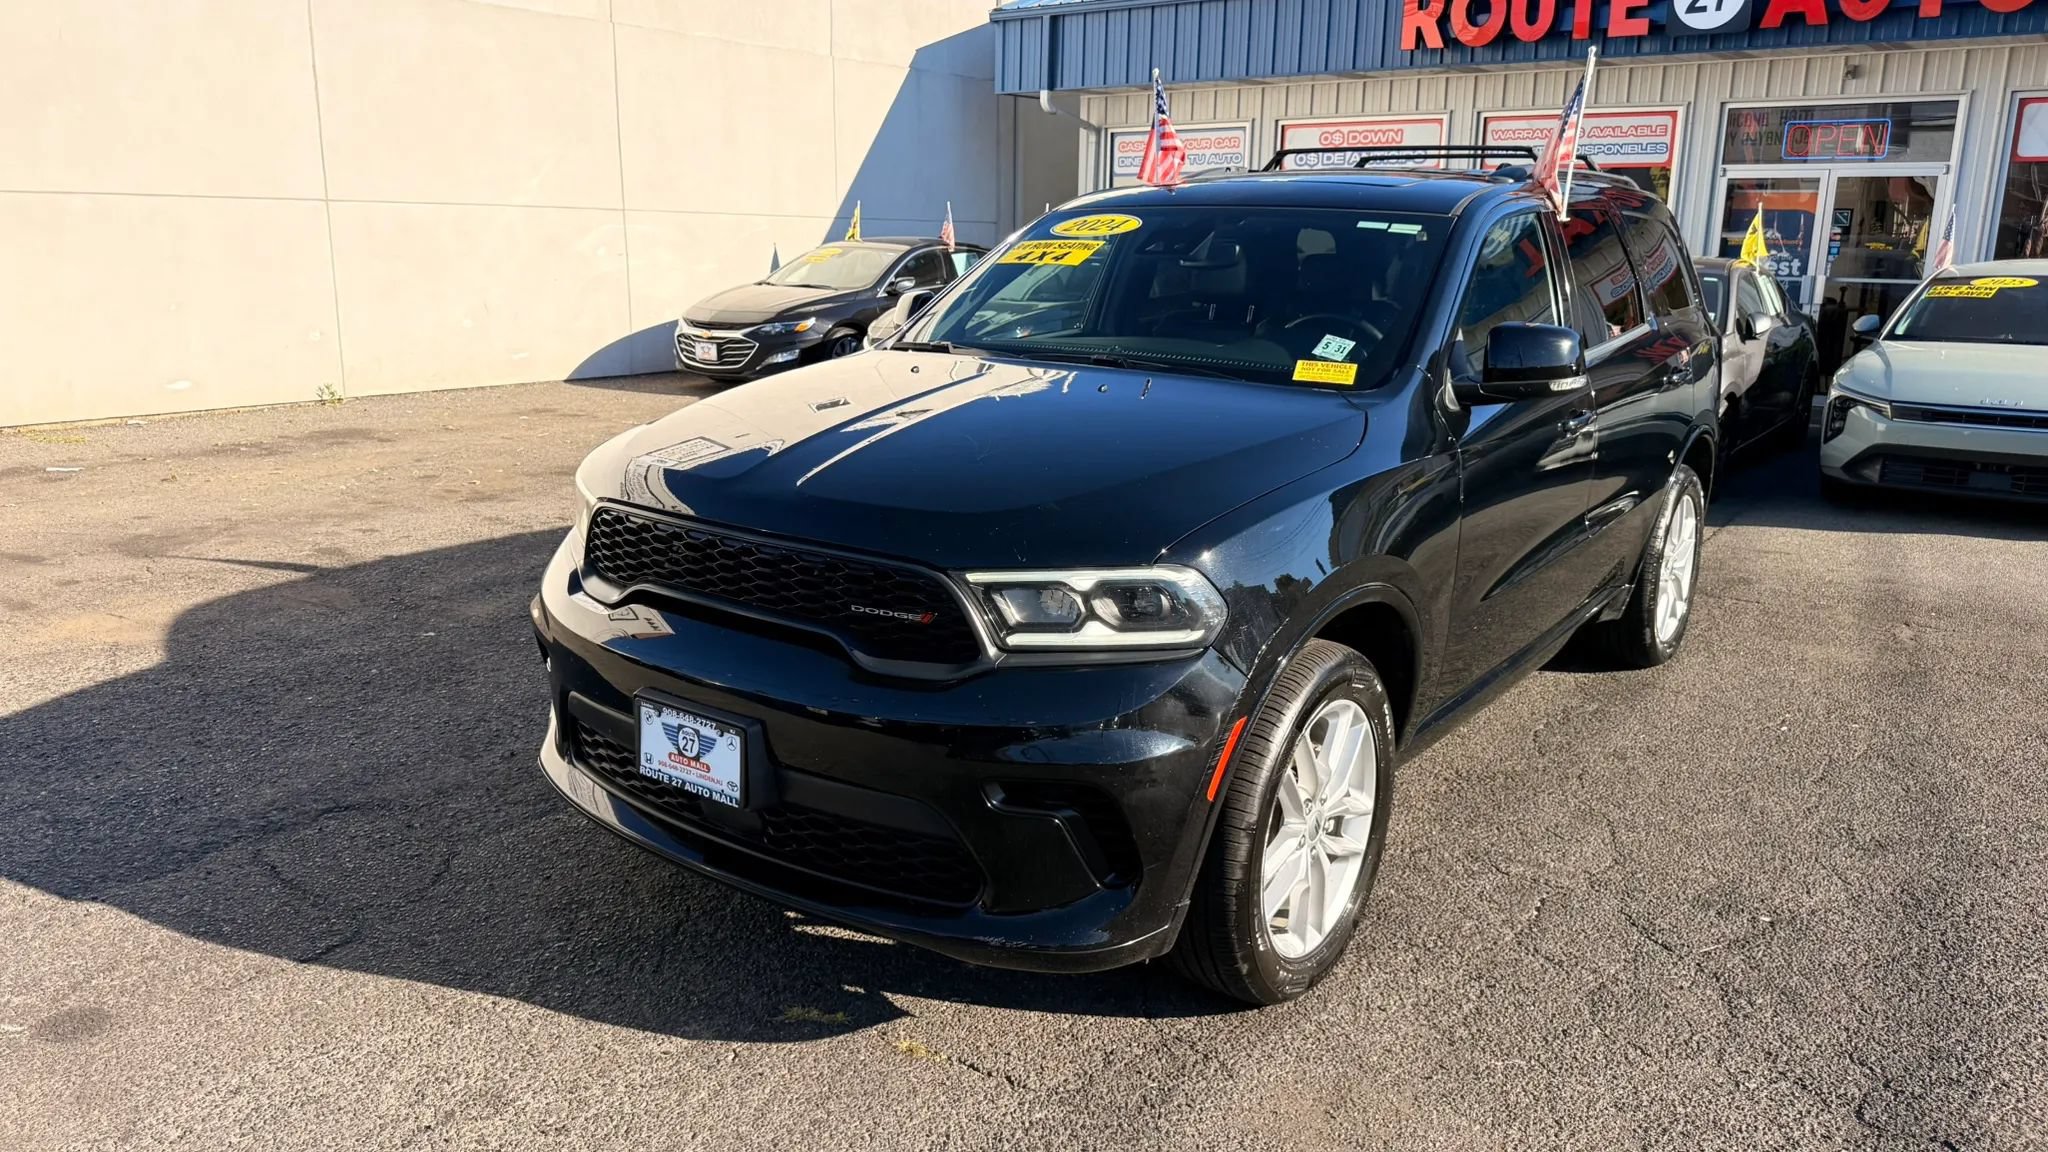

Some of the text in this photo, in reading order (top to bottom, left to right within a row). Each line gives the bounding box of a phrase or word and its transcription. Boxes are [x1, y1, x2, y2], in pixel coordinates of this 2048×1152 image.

[1346, 128, 1404, 145] DOWN
[1492, 124, 1668, 141] WARRANS AVAILABLE
[1787, 123, 1888, 156] OPEN
[1213, 136, 1241, 149] CAR
[1575, 142, 1668, 155] DISPONIBLES
[1117, 152, 1243, 168] DINE TU AUTO
[1321, 152, 1346, 166] DE
[1063, 218, 1132, 232] 2024
[1014, 250, 1072, 261] 4X4
[1321, 341, 1347, 354] 5 31
[850, 604, 922, 621] DODGE
[682, 737, 696, 753] 27
[671, 754, 709, 772] AUTO MALL
[640, 765, 739, 808] ROUTE 27 AUTO MALL
